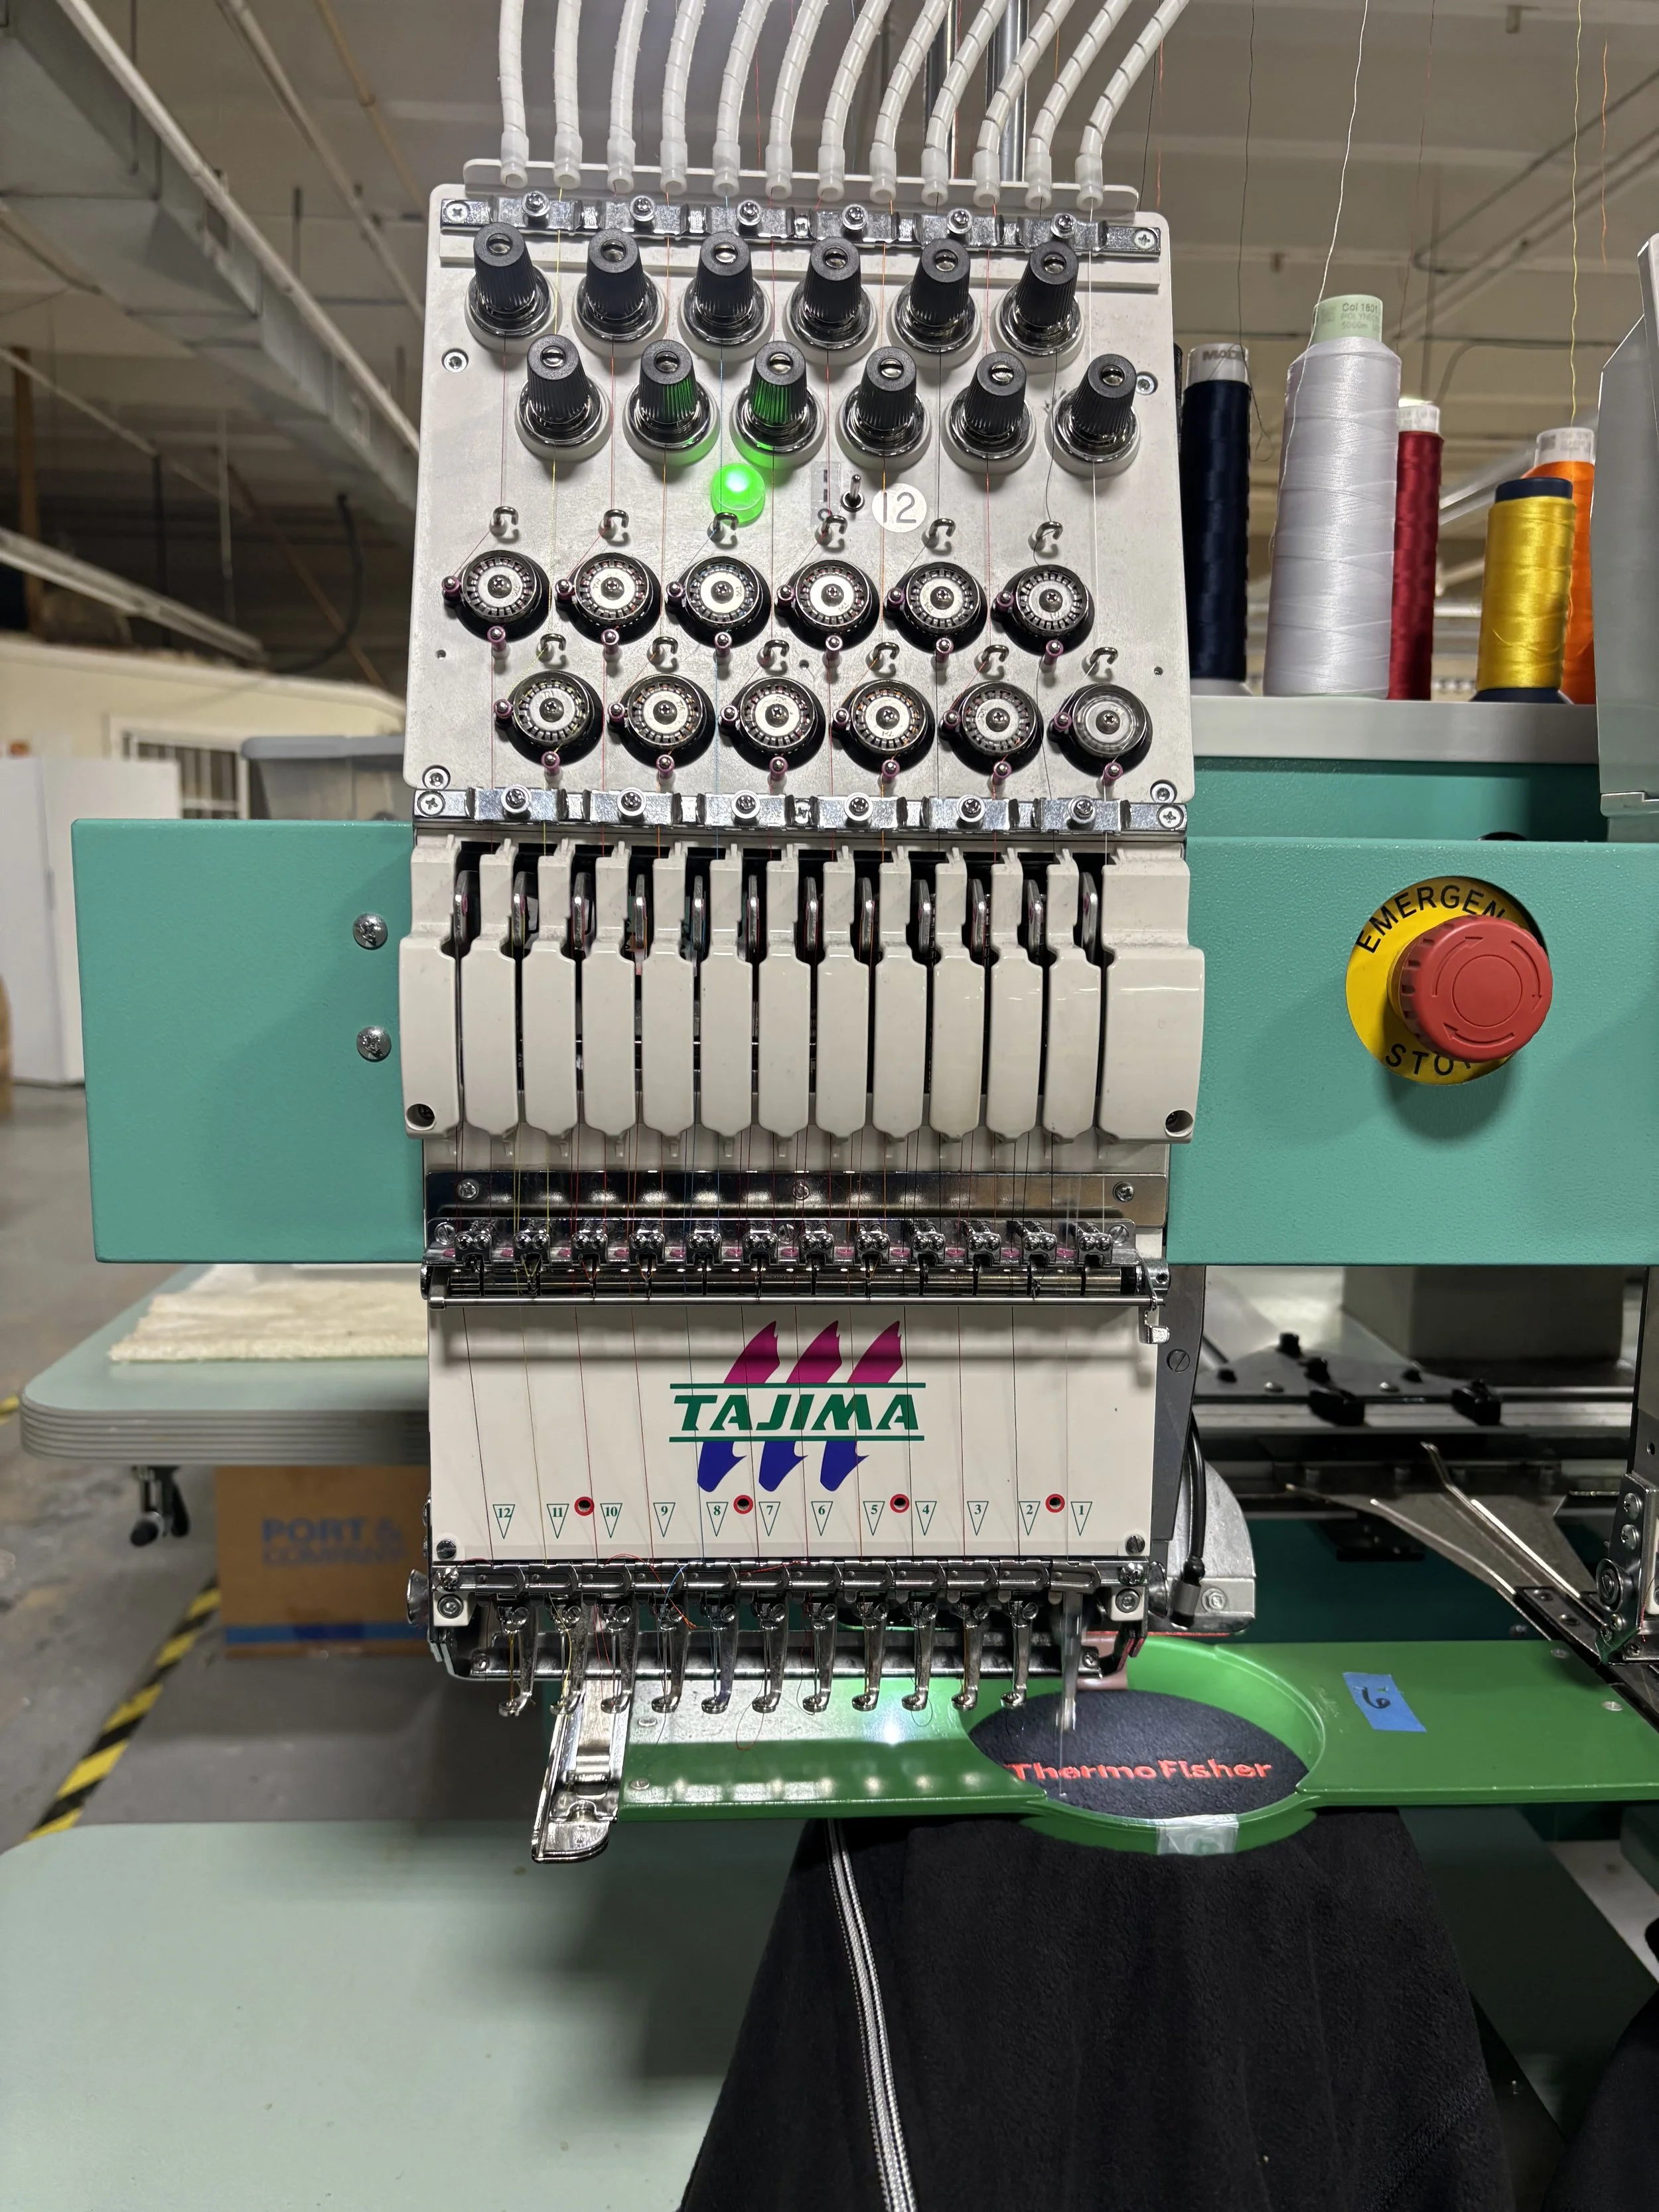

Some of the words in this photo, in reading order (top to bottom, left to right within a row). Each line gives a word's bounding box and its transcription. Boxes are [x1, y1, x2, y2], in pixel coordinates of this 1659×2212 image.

[1342, 303, 1358, 312] Col
[883, 492, 917, 524] 12
[1357, 885, 1506, 953] EMERGEN
[674, 1394, 918, 1431] TAJIMA
[498, 1507, 511, 1518] 12
[553, 1507, 563, 1518] 11
[605, 1507, 618, 1517] 10
[661, 1506, 668, 1516] 9
[713, 1505, 721, 1516] 8
[766, 1505, 773, 1515] 7
[818, 1505, 826, 1515] 6
[871, 1505, 878, 1514] 5
[922, 1505, 930, 1514] 4
[974, 1505, 981, 1514] 3
[1026, 1505, 1033, 1514] 2
[1079, 1505, 1084, 1515] 1
[261, 1517, 366, 1542] PORT
